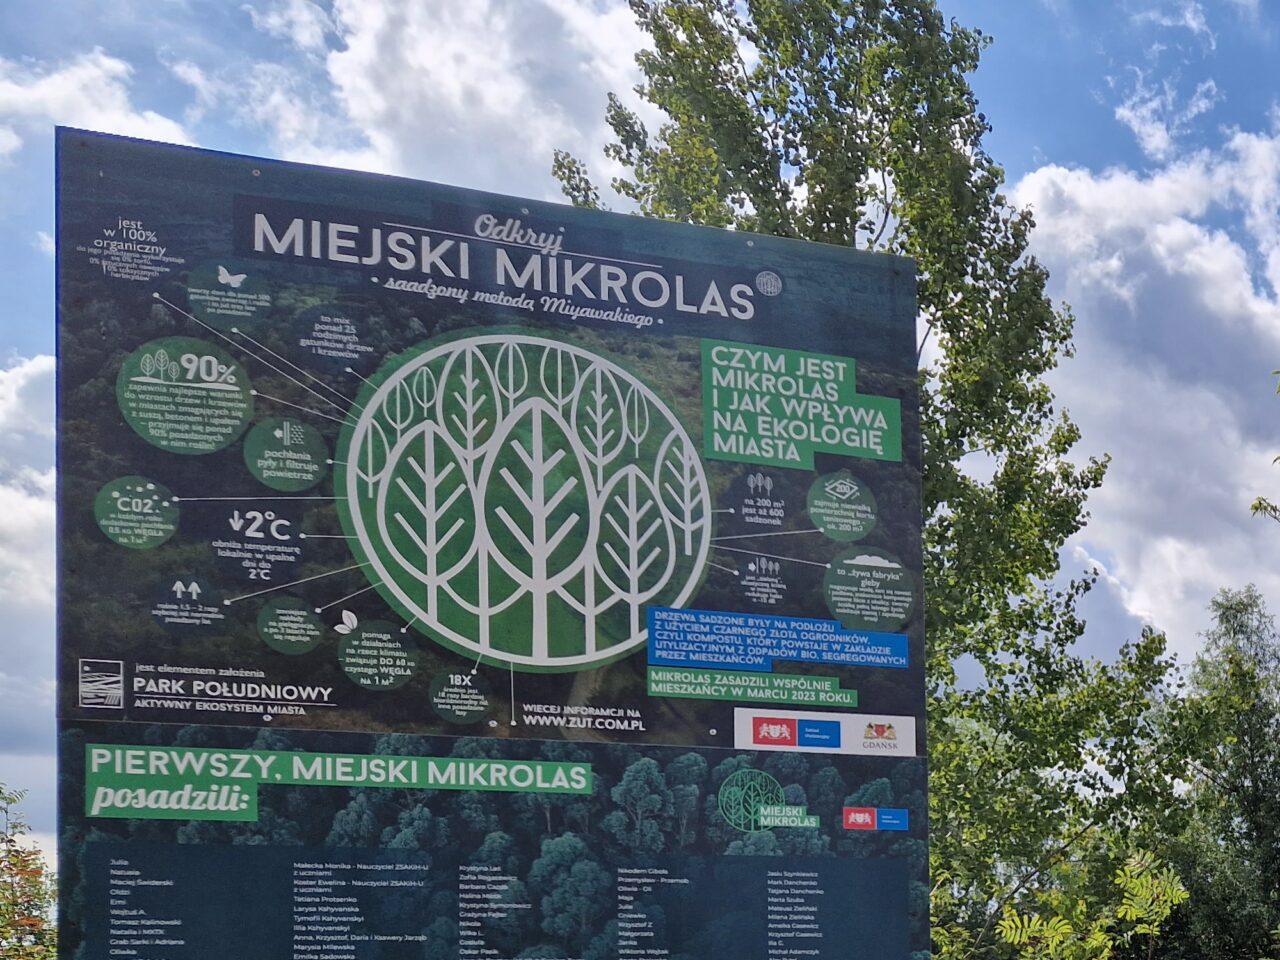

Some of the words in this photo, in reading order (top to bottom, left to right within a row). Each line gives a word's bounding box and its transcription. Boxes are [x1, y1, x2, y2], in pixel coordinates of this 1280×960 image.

[118, 216, 143, 230] jest
[104, 229, 115, 237] w
[123, 229, 157, 242] 100%
[474, 214, 566, 254] Odkryj
[94, 240, 166, 256] organiczny
[254, 213, 469, 280] MIEJSKI
[496, 249, 756, 320] MIKROLAS
[472, 290, 534, 311] metodą
[540, 296, 653, 328] Miyawakiego
[315, 323, 342, 332] ponad
[313, 331, 358, 342] rodzimych
[300, 339, 343, 349] gatunków
[347, 343, 374, 352] drzew
[181, 354, 236, 383] 90%
[711, 346, 785, 373] CZYM
[796, 358, 847, 382] JEST
[128, 384, 166, 392] zapewnia
[169, 387, 206, 396] najlepsze
[210, 391, 242, 399] warunki
[712, 367, 838, 402] MIKROLAS
[175, 396, 200, 404] drzew
[139, 402, 175, 411] miastach
[178, 406, 229, 416] zmagających
[713, 388, 718, 407] I
[729, 391, 771, 414] JAK
[781, 397, 888, 430] WPŁYWA
[165, 414, 202, 422] betonem
[148, 421, 189, 430] przyjmuje
[714, 410, 748, 433] NA
[758, 416, 883, 455] EKOLOGIĘ
[149, 428, 167, 437] 90%
[169, 432, 223, 441] posadzonych
[714, 433, 800, 461] MIASTA
[264, 449, 311, 461] pochłania
[258, 459, 277, 470] pyły
[286, 460, 318, 472] filtruje
[263, 469, 314, 480] powietrze
[757, 499, 771, 507] 200
[742, 507, 756, 515] jest
[769, 509, 784, 517] 600
[745, 515, 782, 525] sadzonek
[212, 540, 241, 549] obniża
[244, 542, 300, 554] temperaturę
[218, 549, 252, 559] lokalnie
[266, 551, 295, 563] upalne
[243, 560, 256, 568] dni
[259, 561, 271, 569] do
[861, 580, 880, 588] gleby
[655, 611, 696, 622] DRZEWA
[700, 614, 745, 625] SADZONE
[748, 618, 771, 628] BYŁY
[774, 620, 787, 628] NA
[791, 621, 834, 633] PODŁOŻU
[362, 632, 391, 640] pomaga
[655, 621, 661, 629] Z
[666, 621, 709, 632] UŻYCIEM
[713, 625, 766, 637] CZARNEGO
[770, 629, 797, 639] ZŁOTA
[361, 640, 401, 648] działaniach
[655, 631, 684, 640] CZYLI
[746, 635, 777, 646] KTÓRY
[781, 639, 828, 651] POWSTAJE
[831, 642, 841, 651] W
[844, 644, 890, 655] ZAKŁADZIE
[655, 640, 735, 653] UTYLIZACYJNYM
[740, 646, 745, 654] Z
[749, 645, 797, 658] ODPADÓW
[822, 651, 906, 665] SEGREGOWANYCH
[655, 650, 686, 660] PRZEZ
[346, 657, 377, 665] związuje
[136, 663, 154, 673] jest
[158, 664, 215, 676] elementem
[219, 667, 265, 677] założenia
[345, 666, 378, 674] czystego
[380, 666, 411, 675] WĘGLA
[449, 675, 472, 686] 18X
[651, 671, 710, 683] MIKROLAS
[715, 674, 768, 687] ZASADZILI
[773, 676, 831, 691] WSPÓLNIE
[133, 678, 185, 694] PARK
[193, 681, 333, 701] POŁUDNIOWY
[651, 683, 726, 696] MIESZKAŃCY
[731, 687, 743, 697] W
[748, 688, 787, 699] MARCU
[792, 690, 815, 700] 2023
[819, 692, 853, 703] ROKU.
[135, 699, 191, 710] AKTYWNY
[195, 701, 264, 713] EKOSYSTEM
[268, 705, 306, 715] MIASTA
[523, 704, 560, 714] WIECEJ
[627, 709, 641, 718] NA
[523, 714, 646, 731] WWW.ZUT.COM.PL
[863, 741, 898, 750] GDAŃSK
[91, 748, 282, 781] PIERWSZY,
[292, 756, 418, 784] MIEJSKI
[428, 761, 587, 790] MIKROLAS
[91, 784, 249, 815] posadzili:
[761, 806, 804, 816] MIEJSKI
[760, 816, 816, 827] MIKROLAS
